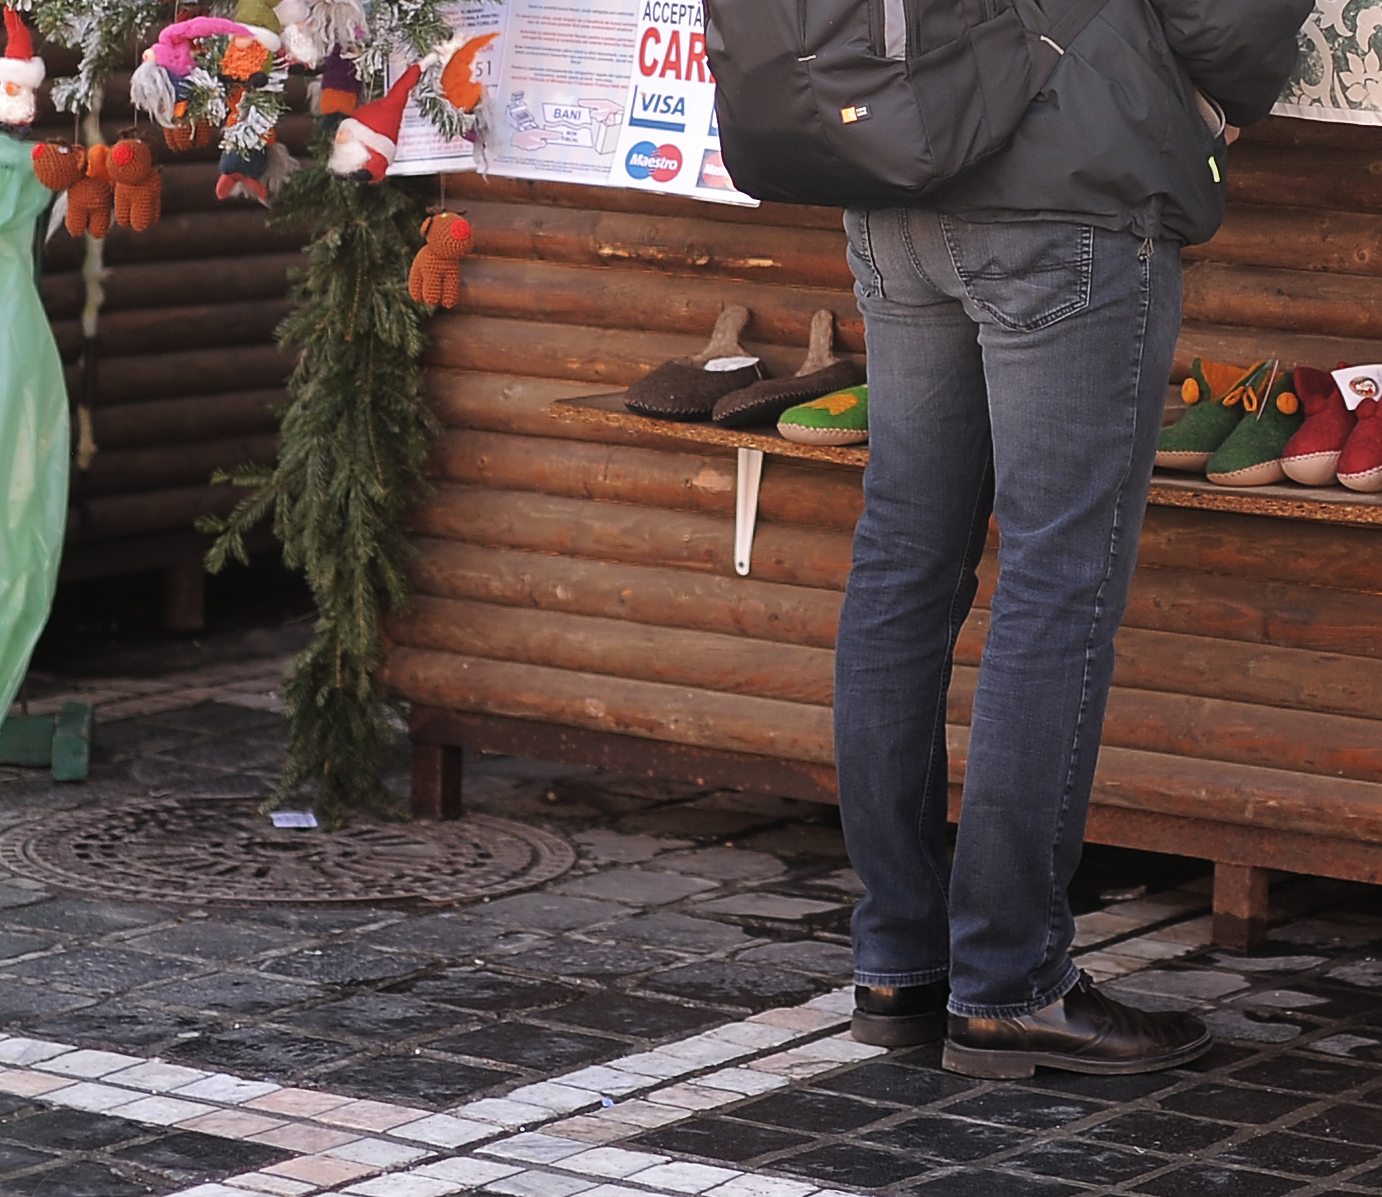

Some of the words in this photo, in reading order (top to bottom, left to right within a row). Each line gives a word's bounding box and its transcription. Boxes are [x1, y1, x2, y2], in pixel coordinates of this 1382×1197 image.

[643, 0, 704, 28] ACCEPTĂ
[639, 26, 717, 84] CAR
[553, 108, 581, 120] BANI
[640, 92, 685, 117] VISA
[629, 152, 678, 171] Maestro
